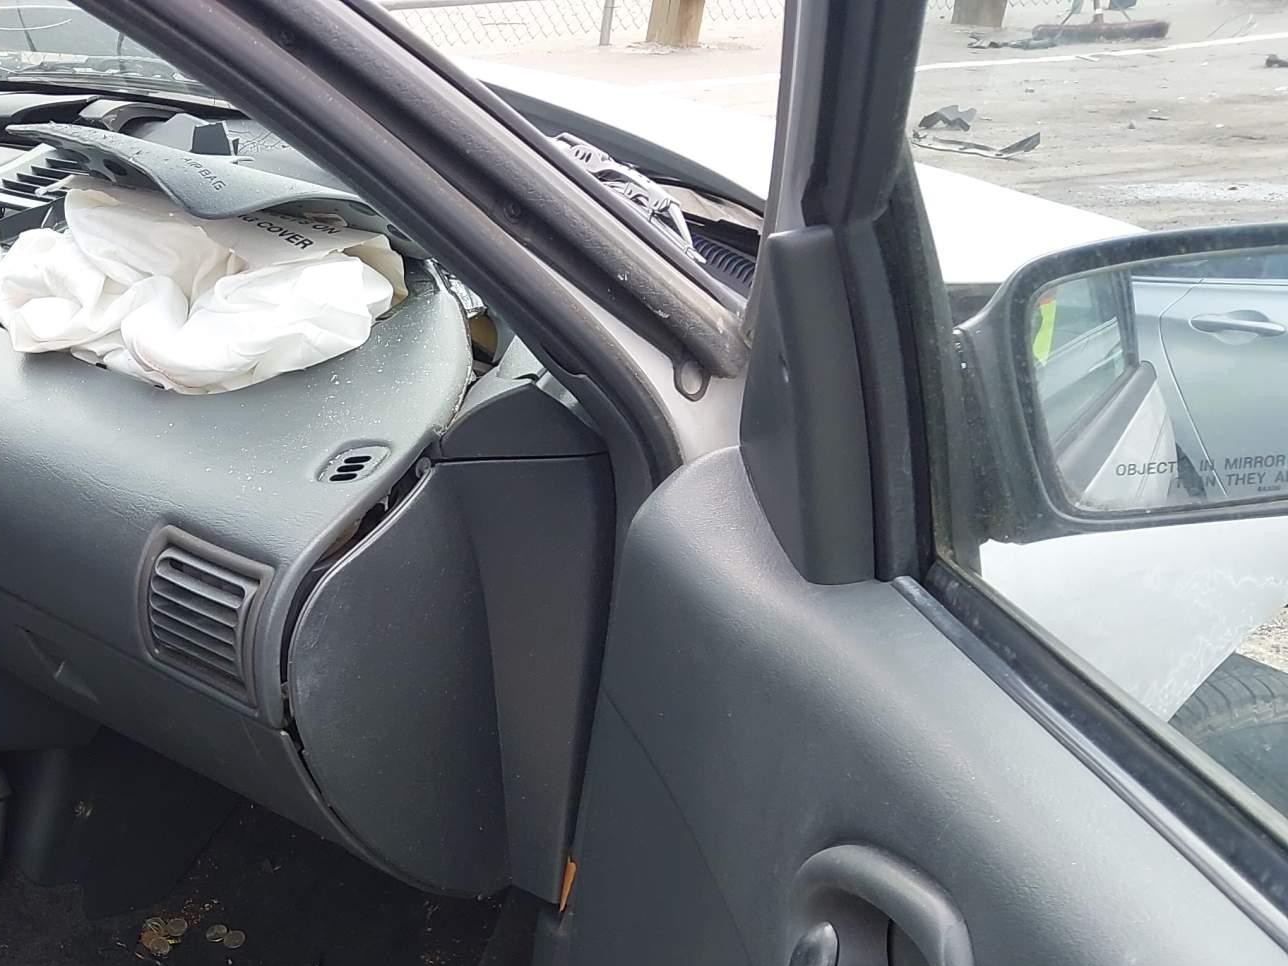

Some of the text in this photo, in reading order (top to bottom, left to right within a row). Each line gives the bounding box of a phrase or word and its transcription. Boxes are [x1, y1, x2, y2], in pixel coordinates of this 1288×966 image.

[256, 221, 314, 250] COVER
[312, 222, 341, 236] ON
[1115, 454, 1286, 477] OBJECT IN MIRROR
[1227, 472, 1266, 487] THEY
